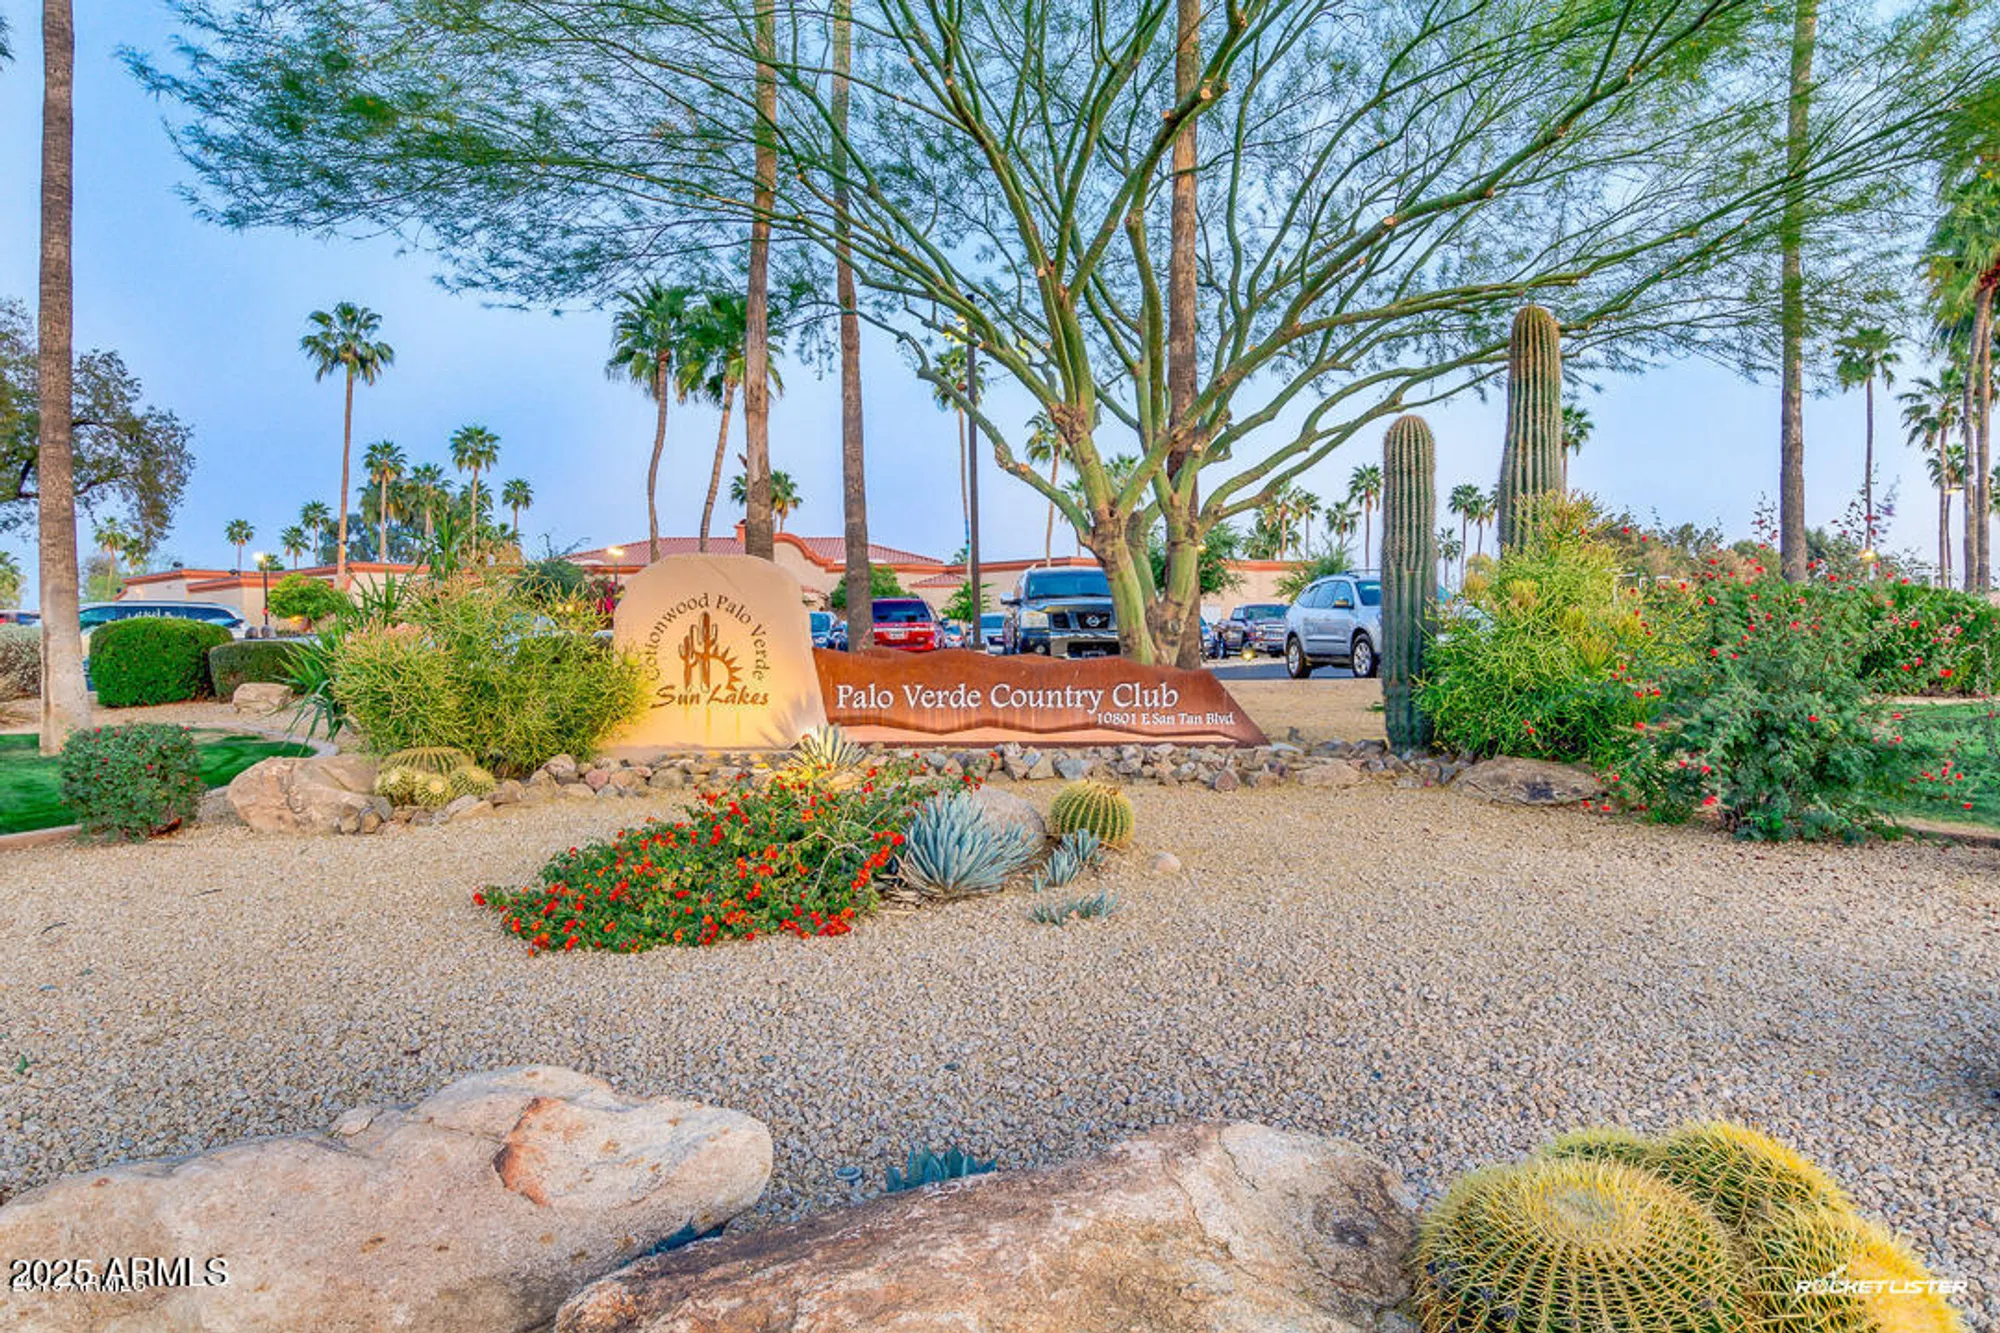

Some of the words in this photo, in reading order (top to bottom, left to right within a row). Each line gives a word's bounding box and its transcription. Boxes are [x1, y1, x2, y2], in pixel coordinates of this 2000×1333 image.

[644, 592, 710, 681] Cottonwood
[715, 594, 752, 625] Palo
[750, 623, 771, 681] Verde
[650, 684, 700, 709] Sun
[707, 683, 769, 706] Lakes
[836, 683, 894, 709] Palo
[902, 683, 981, 709] Verde
[990, 683, 1104, 714] Country
[1112, 682, 1179, 708] Club
[1097, 711, 1137, 725] 10801
[1141, 712, 1150, 725] E
[1151, 712, 1175, 725] San
[1178, 712, 1202, 725] Tan
